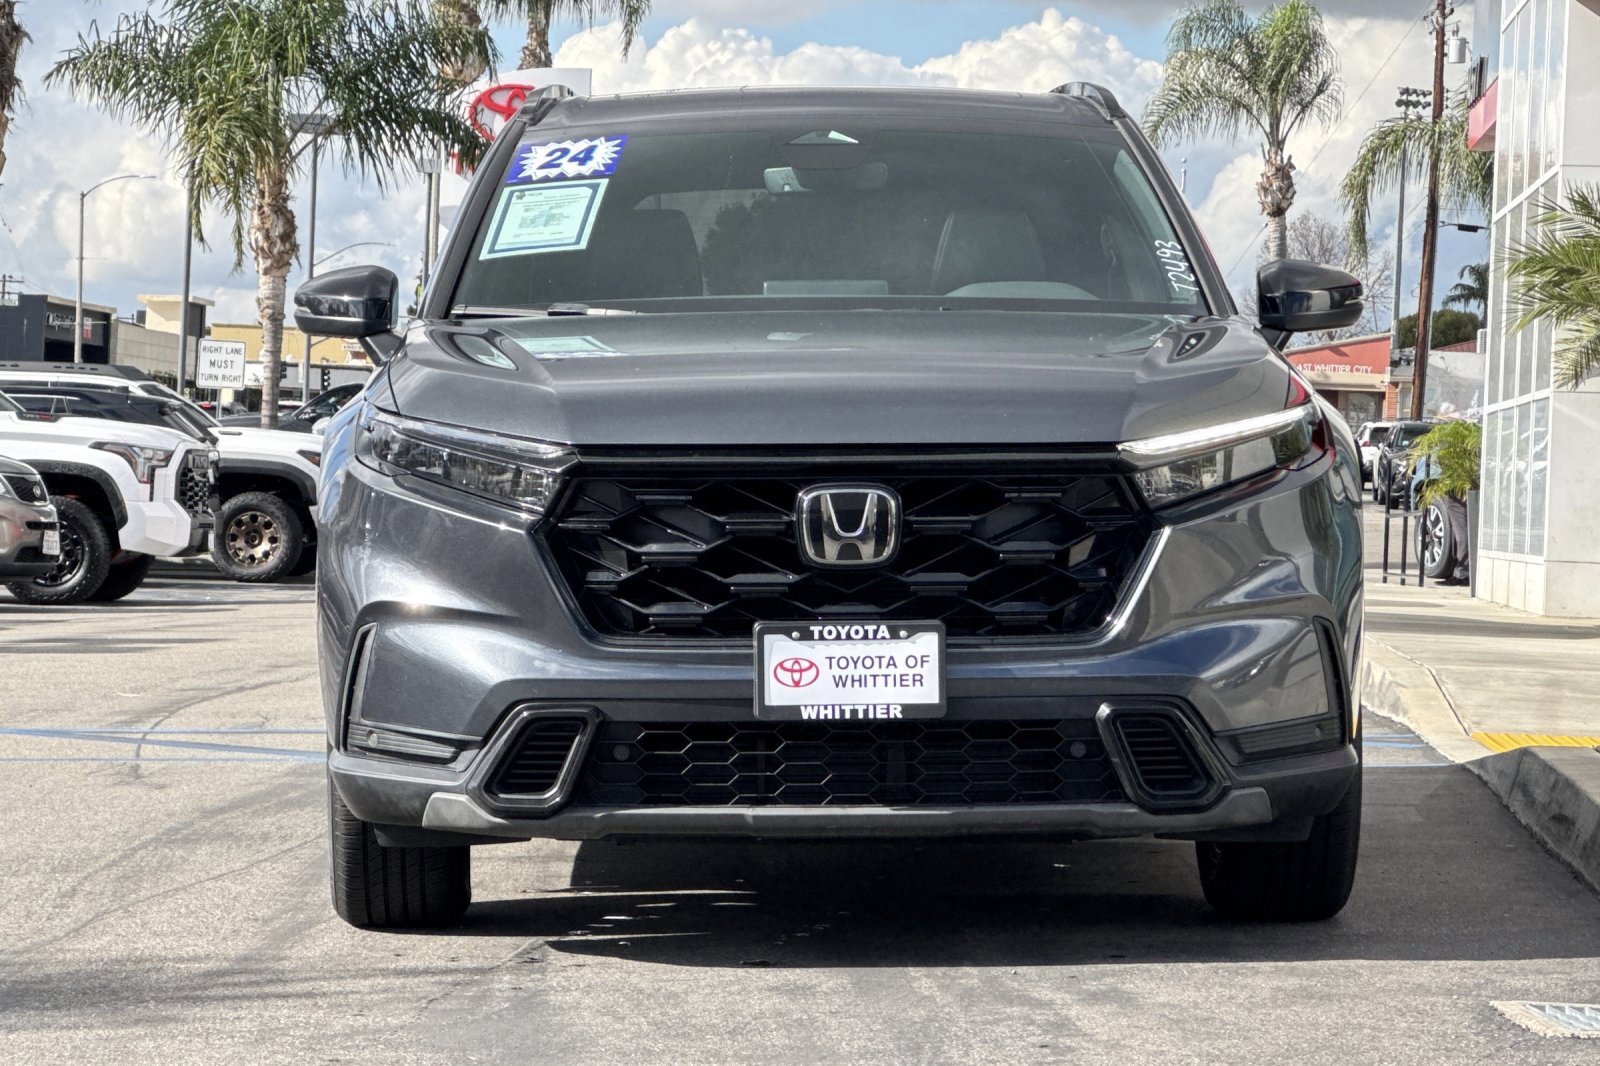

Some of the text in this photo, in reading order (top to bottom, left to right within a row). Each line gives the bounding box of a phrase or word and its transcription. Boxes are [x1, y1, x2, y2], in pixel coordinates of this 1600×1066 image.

[537, 145, 598, 170] 24
[202, 345, 243, 355] RIGHT LANE
[209, 359, 235, 369] MUST
[1314, 363, 1351, 374] WHITTIER
[1353, 366, 1373, 375] CITY
[201, 373, 241, 383] TURN RIGHT
[810, 625, 890, 640] TOYOTA
[825, 655, 931, 670] TOYOTA OF
[832, 674, 924, 688] WHITTIER
[800, 705, 903, 720] WHITTIER
